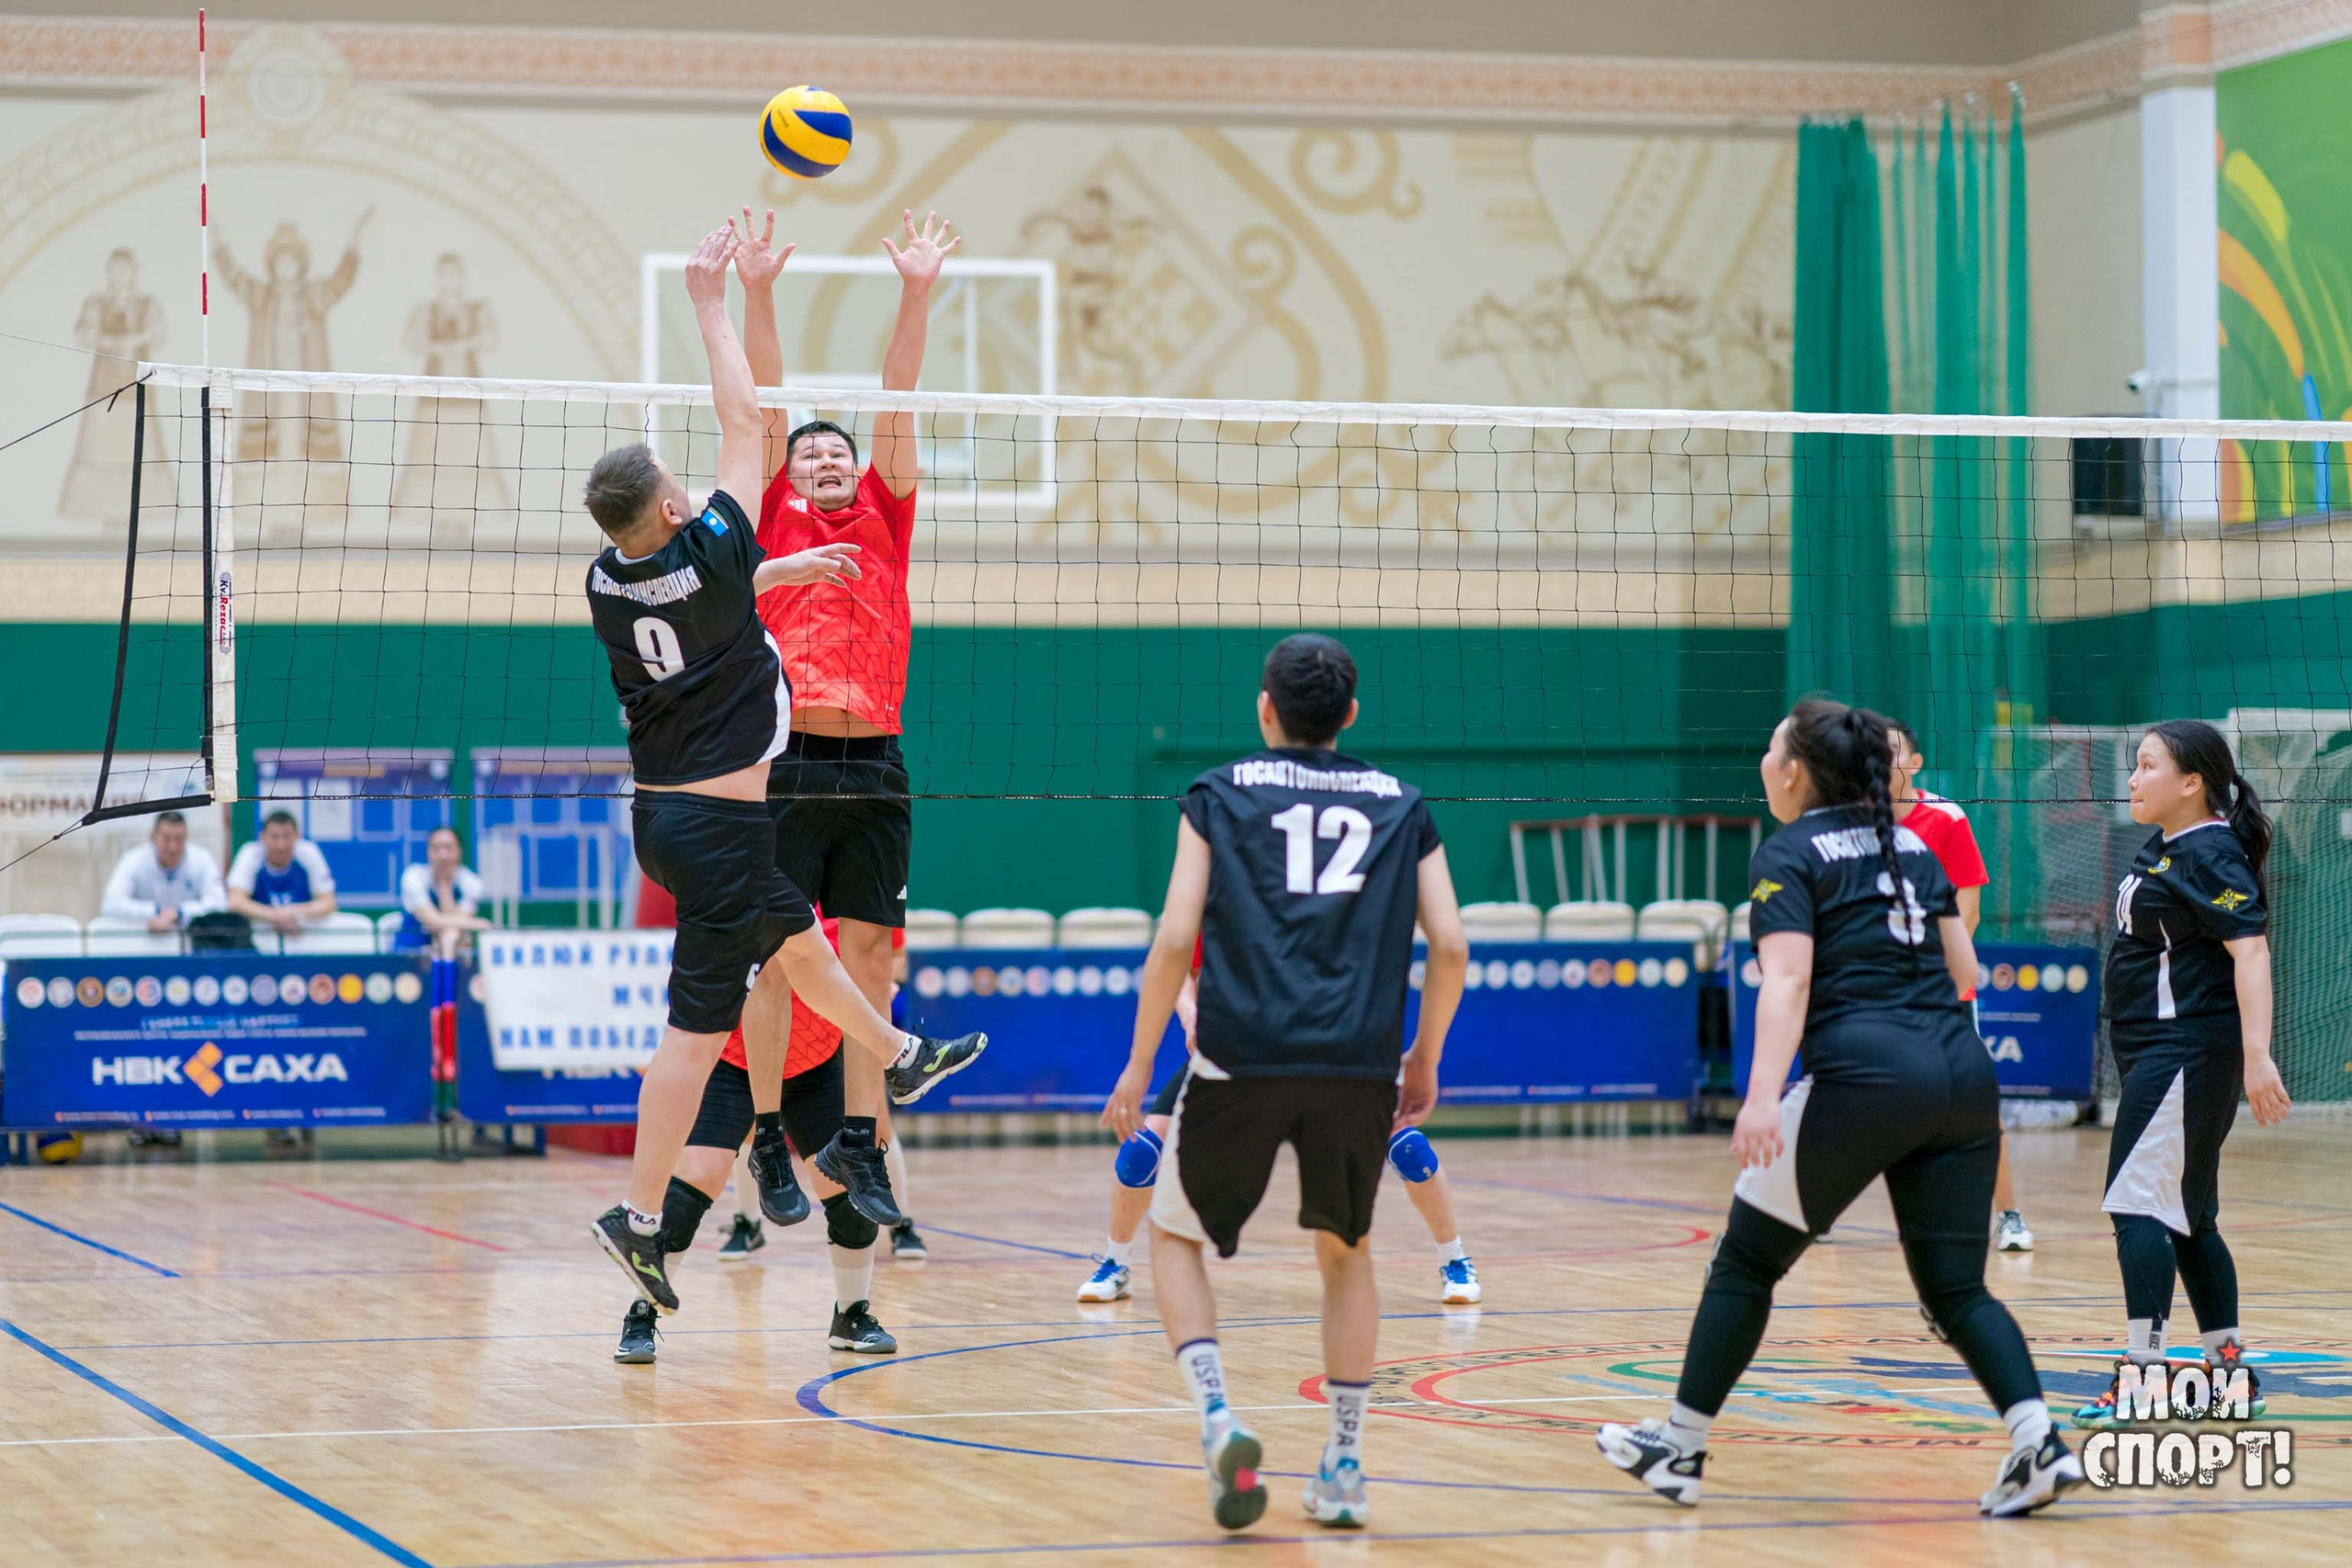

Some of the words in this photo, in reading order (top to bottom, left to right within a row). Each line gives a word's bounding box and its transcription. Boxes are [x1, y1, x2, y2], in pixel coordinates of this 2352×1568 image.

[633, 616, 685, 682] 9
[1271, 803, 1373, 894] 12
[500, 1027, 554, 1049] НАМ
[569, 1026, 660, 1049] ПОБЕД
[92, 1056, 182, 1086] НВК
[223, 1054, 348, 1083] САХА
[2149, 1332, 2160, 1350] NIKE
[1336, 1394, 1362, 1447] USPA
